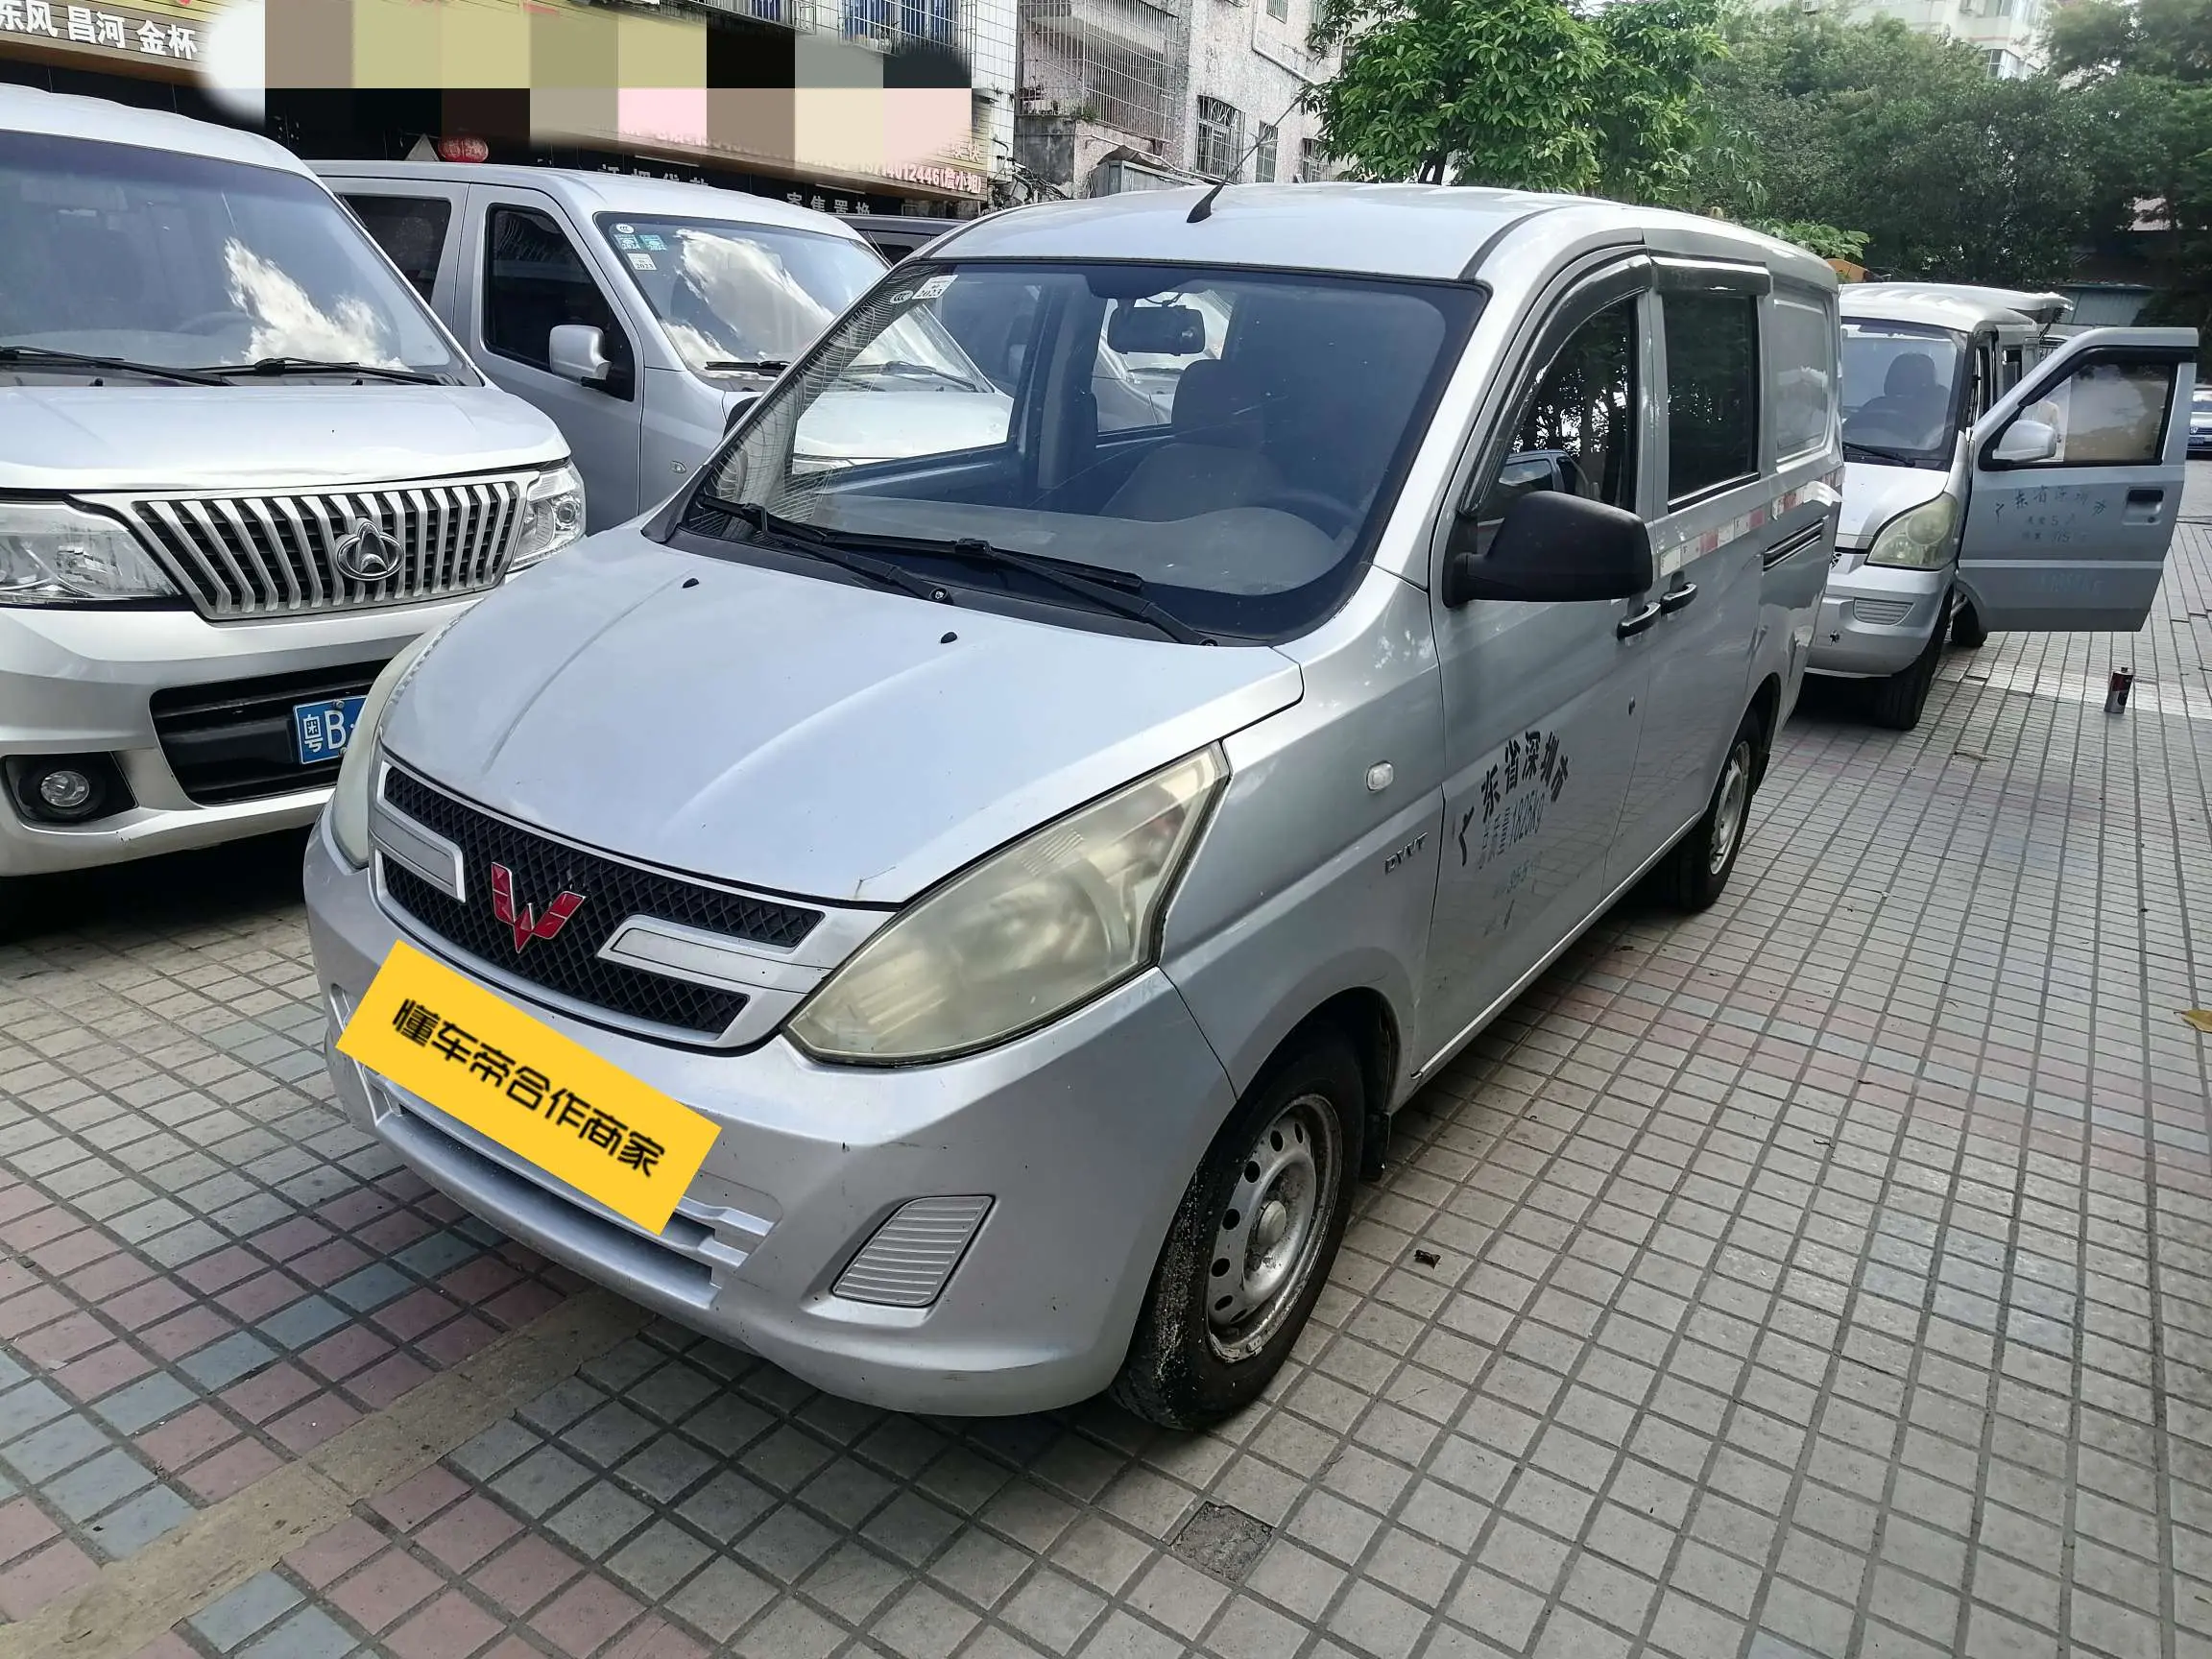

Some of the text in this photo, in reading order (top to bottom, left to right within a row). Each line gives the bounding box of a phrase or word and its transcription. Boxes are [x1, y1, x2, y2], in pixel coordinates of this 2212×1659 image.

[0, 0, 198, 60] 东风 昌河 金杯
[916, 288, 943, 298] 2023
